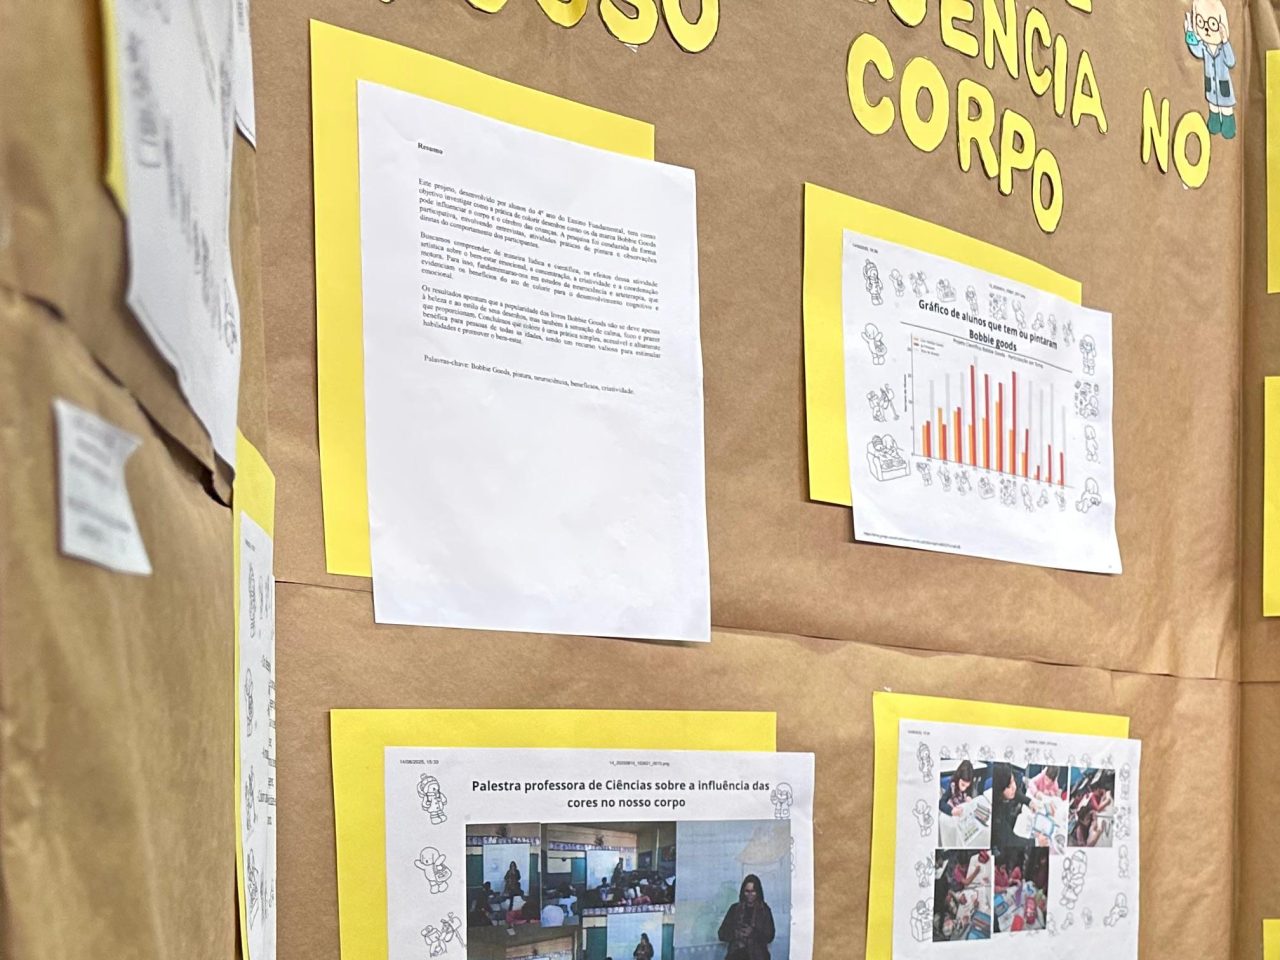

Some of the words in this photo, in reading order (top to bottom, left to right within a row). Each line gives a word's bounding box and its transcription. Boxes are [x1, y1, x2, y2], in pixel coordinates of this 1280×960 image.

[846, 32, 1064, 234] CORPO
[1140, 87, 1211, 190] NO
[919, 299, 949, 315] Gráfico
[950, 307, 960, 319] de
[961, 312, 986, 327] alunos
[987, 321, 1001, 331] que
[1003, 324, 1019, 336] tem
[1018, 328, 1028, 339] ou
[1029, 333, 1057, 349] pintaram
[969, 329, 994, 345] Bobbie
[995, 338, 1018, 353] goods
[472, 780, 520, 791] Palestra
[524, 779, 585, 793] professora
[588, 779, 602, 790] de
[605, 779, 651, 790] Ciências
[654, 779, 685, 790] sobre
[688, 782, 694, 790] a
[698, 780, 749, 790] influência
[752, 780, 770, 791] das
[567, 799, 597, 807] cores
[601, 799, 615, 807] no
[618, 799, 650, 807] nosso
[654, 799, 685, 809] corpo
